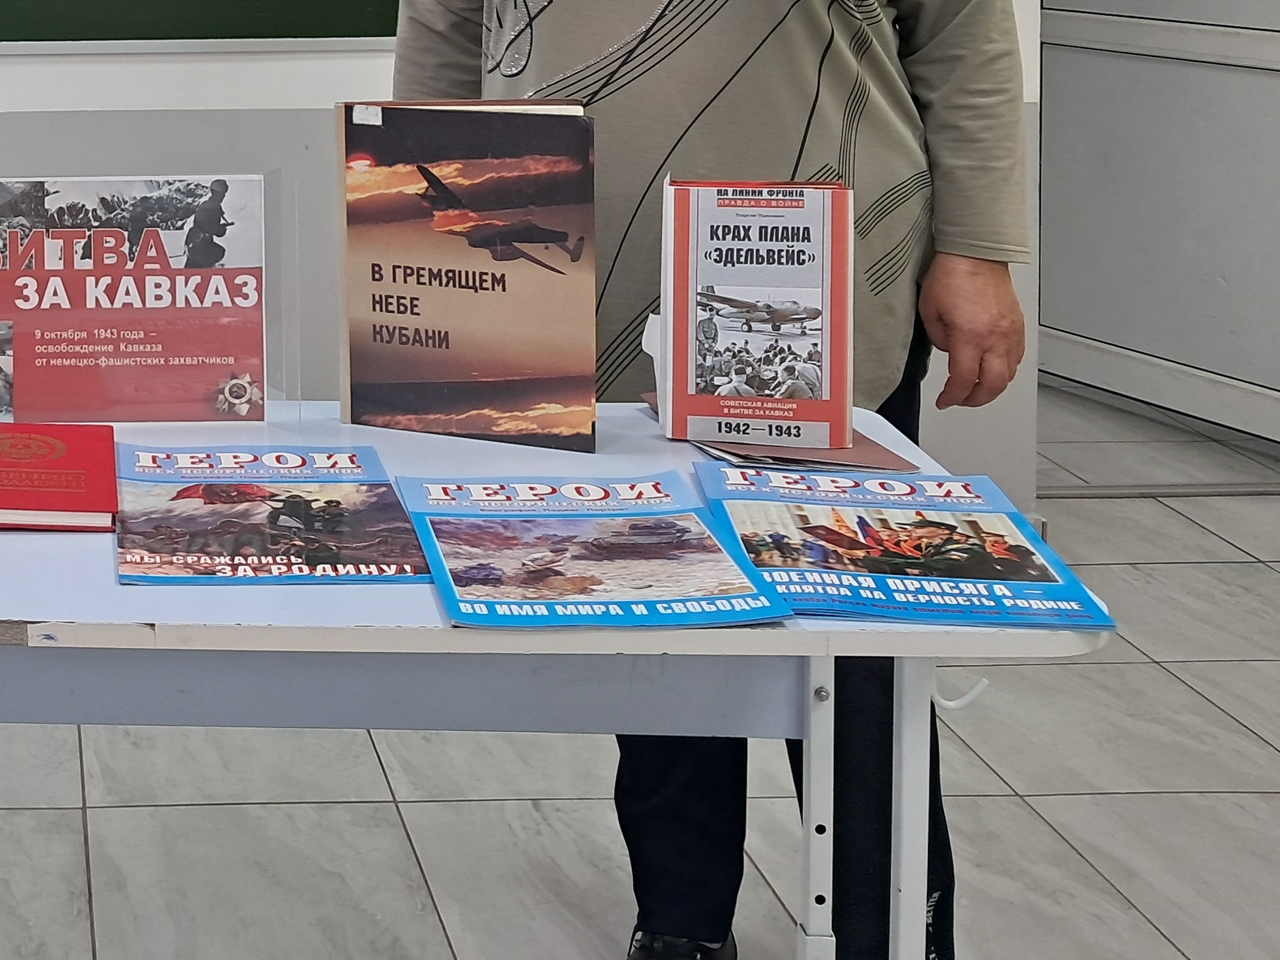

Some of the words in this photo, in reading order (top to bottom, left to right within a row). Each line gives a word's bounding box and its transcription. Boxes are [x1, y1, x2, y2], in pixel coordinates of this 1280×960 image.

[716, 188, 729, 197] НА
[732, 188, 764, 197] ЛИНИИ
[766, 189, 805, 198] ФРОНТА
[718, 199, 756, 207] ПРАВДА
[771, 199, 804, 208] ВОЙНЕ
[709, 224, 752, 242] КРАХ
[758, 225, 812, 243] ПЛАНА
[703, 244, 816, 267] «ЭДЕЛЬВЕЙС»
[370, 262, 384, 283] В
[391, 264, 508, 293] ГРЕМЯЩЕМ
[14, 276, 71, 310] ЗА
[86, 274, 259, 309] КАВКАЗ
[371, 293, 421, 317] НЕБЕ
[34, 329, 42, 339] 9
[44, 330, 87, 341] октября
[93, 328, 118, 339] 1943
[120, 330, 144, 340] года
[371, 324, 451, 350] КУБАНИ
[35, 343, 114, 354] освобождение
[120, 342, 163, 352] Кавказа
[35, 357, 47, 366] от
[50, 355, 165, 368] немецко-фашистских
[168, 355, 235, 366] захватчиков
[720, 400, 761, 408] СОВЕТСКАЯ
[763, 401, 797, 410] АВИАЦИЯ
[766, 409, 794, 417] КАВКАЗ
[134, 451, 362, 468] ГЕРОИ
[421, 481, 672, 501] ГЕРОИ
[720, 467, 983, 500] ГЕРОИ
[727, 485, 772, 493] ВСЕХ
[780, 489, 926, 502] ИСТОРИЧЕСКИХ
[933, 496, 985, 505] ЭПОХ
[125, 554, 161, 563] МЫ
[172, 555, 303, 564] СРАЖАЛИСЬ
[215, 565, 258, 577] ЗА
[271, 564, 417, 577] РОДИНУ!
[888, 578, 1014, 596] ПРИСЯГА
[458, 602, 489, 615] ВО
[496, 603, 549, 616] ИМЯ
[557, 603, 625, 616] МИРА
[630, 603, 649, 615] И
[656, 596, 771, 614] СВОБОДЫ
[776, 584, 852, 597] КЛЯТВА
[859, 589, 887, 600] НА
[896, 591, 995, 607] ВЕРНОСТЬ
[1002, 598, 1085, 612] РОДИНЕ
